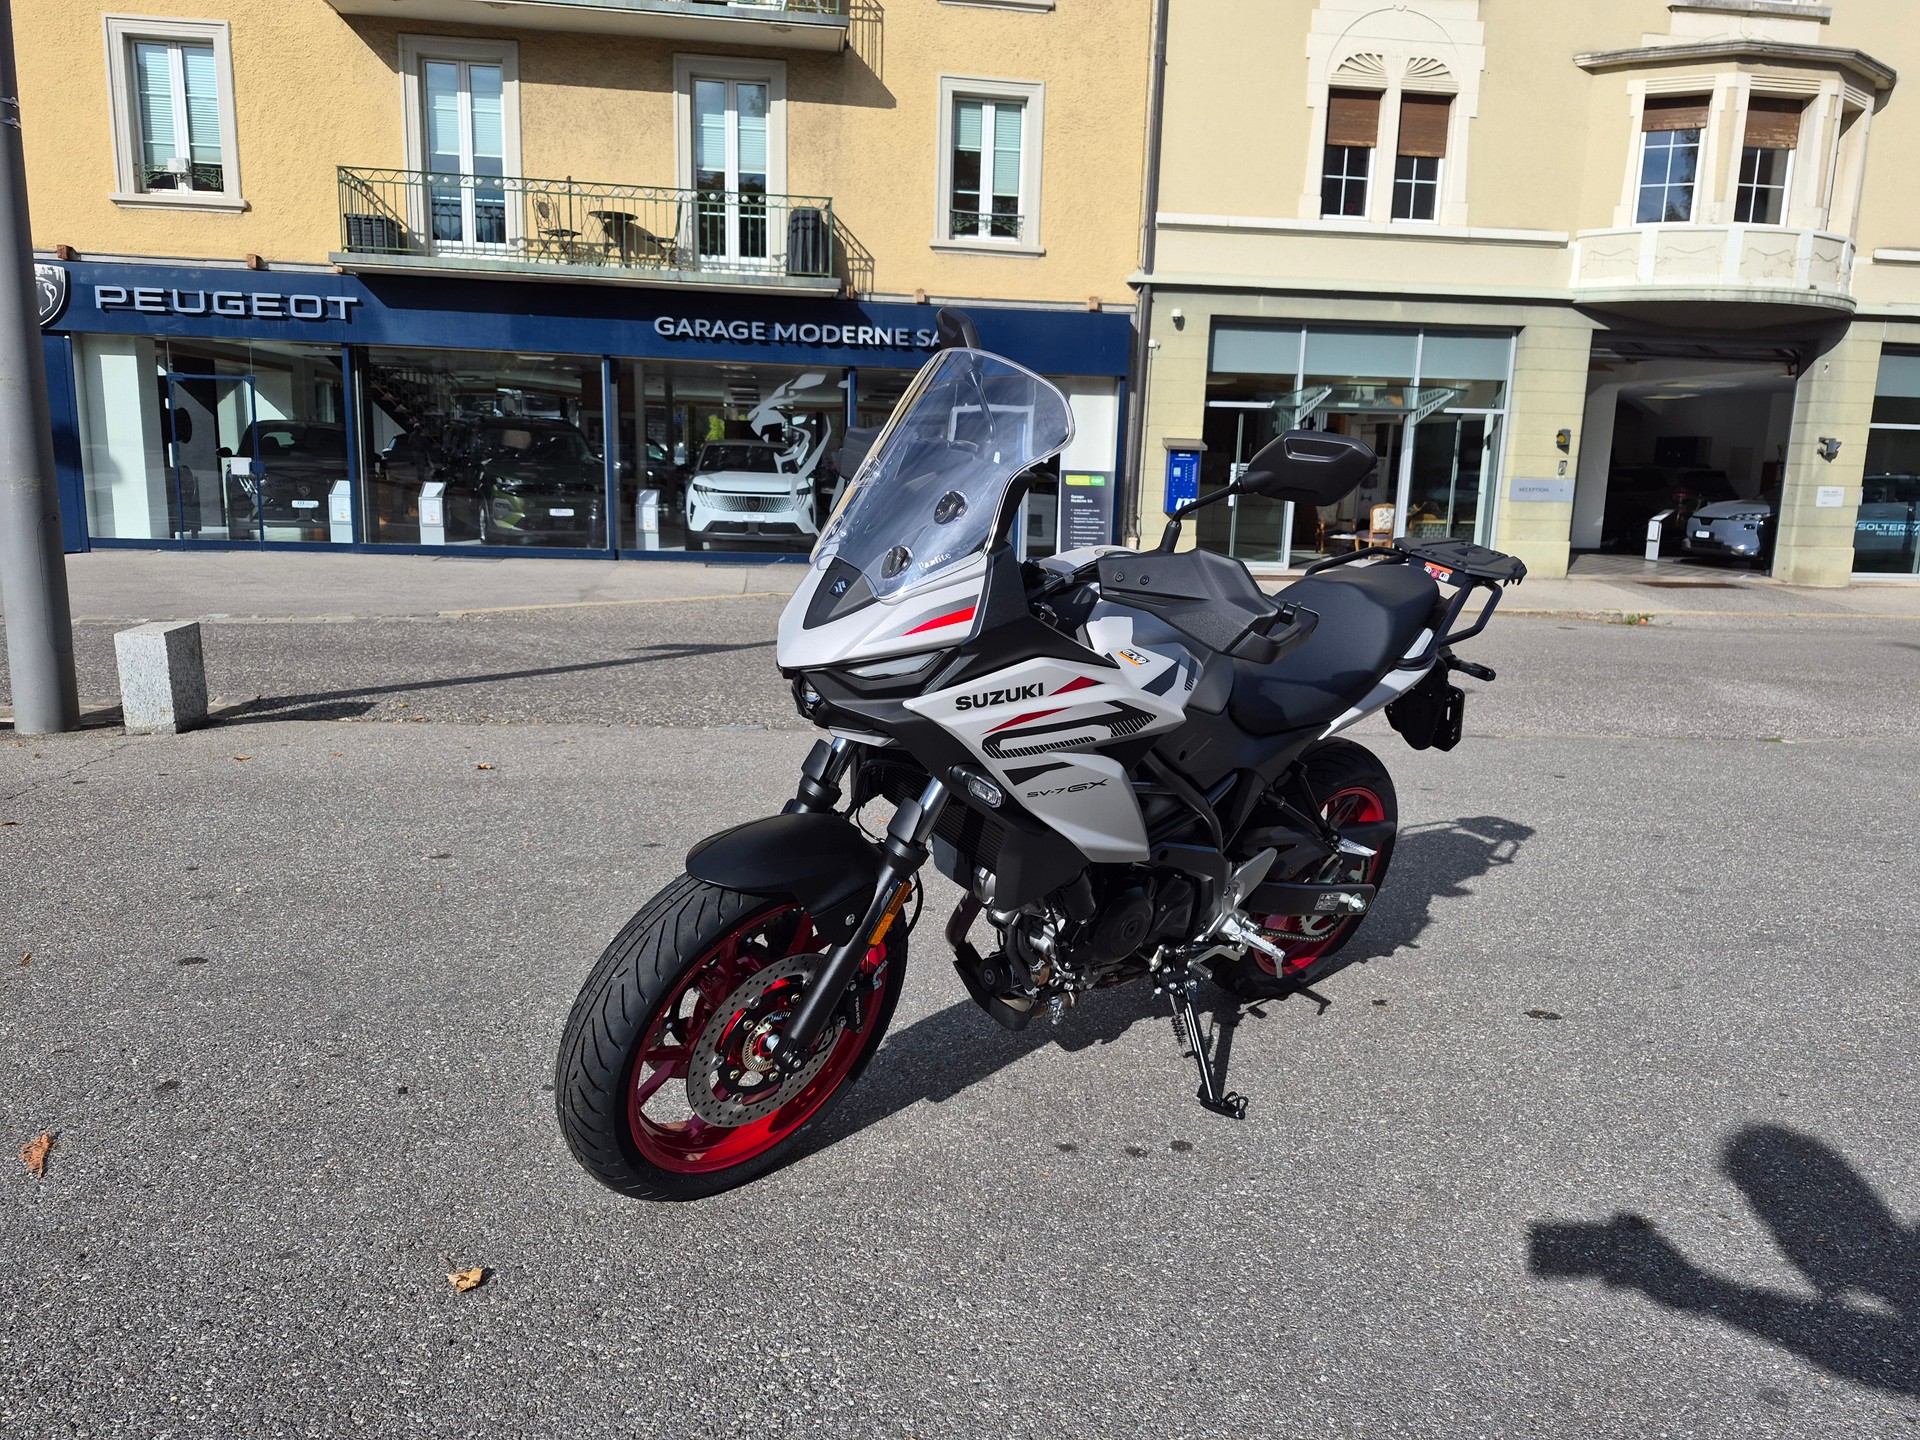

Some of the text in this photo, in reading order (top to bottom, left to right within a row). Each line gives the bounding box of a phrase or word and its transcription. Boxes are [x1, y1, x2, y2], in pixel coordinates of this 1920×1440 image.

[94, 285, 358, 320] PEUGEOT
[654, 316, 766, 340] GARAGE
[774, 322, 910, 346] MODERNE
[955, 682, 1044, 711] SUZUKI
